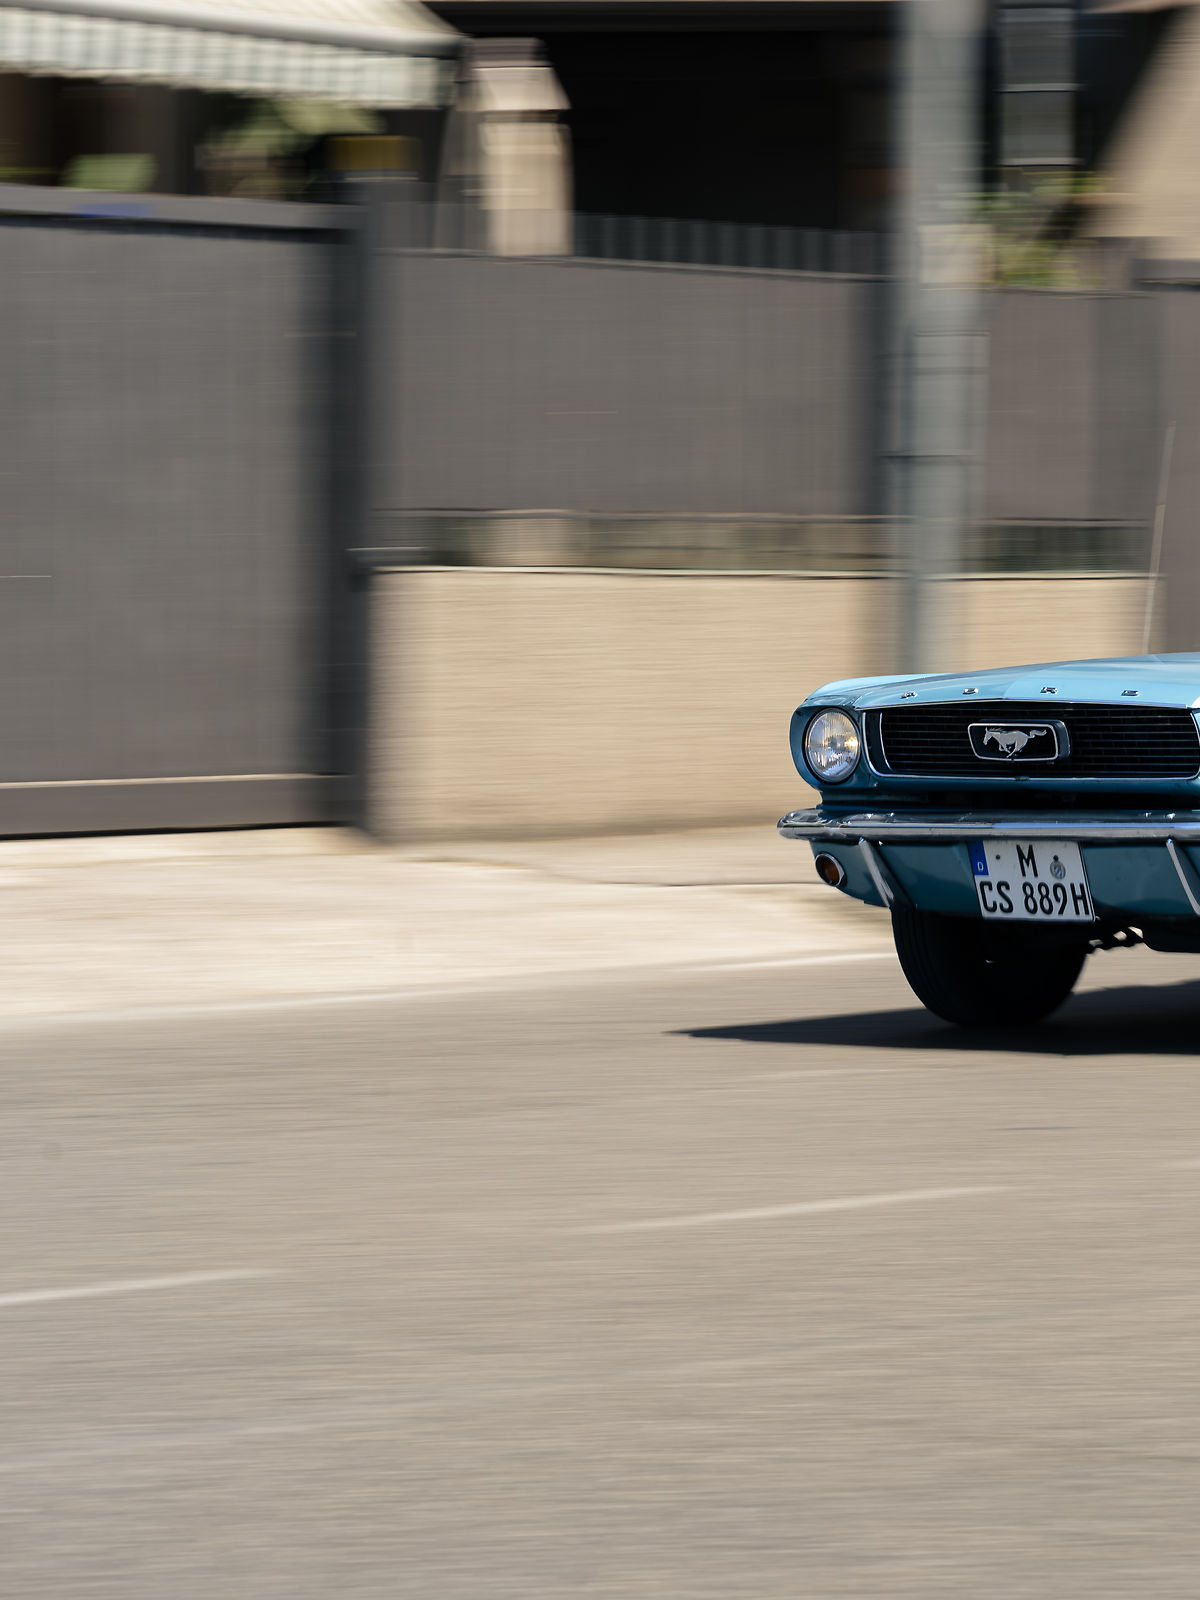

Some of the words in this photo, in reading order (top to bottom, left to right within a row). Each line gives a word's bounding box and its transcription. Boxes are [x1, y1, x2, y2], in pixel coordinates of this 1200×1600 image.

[1016, 844, 1038, 877] M
[979, 881, 1013, 913] CS
[1022, 881, 1090, 915] 889H
